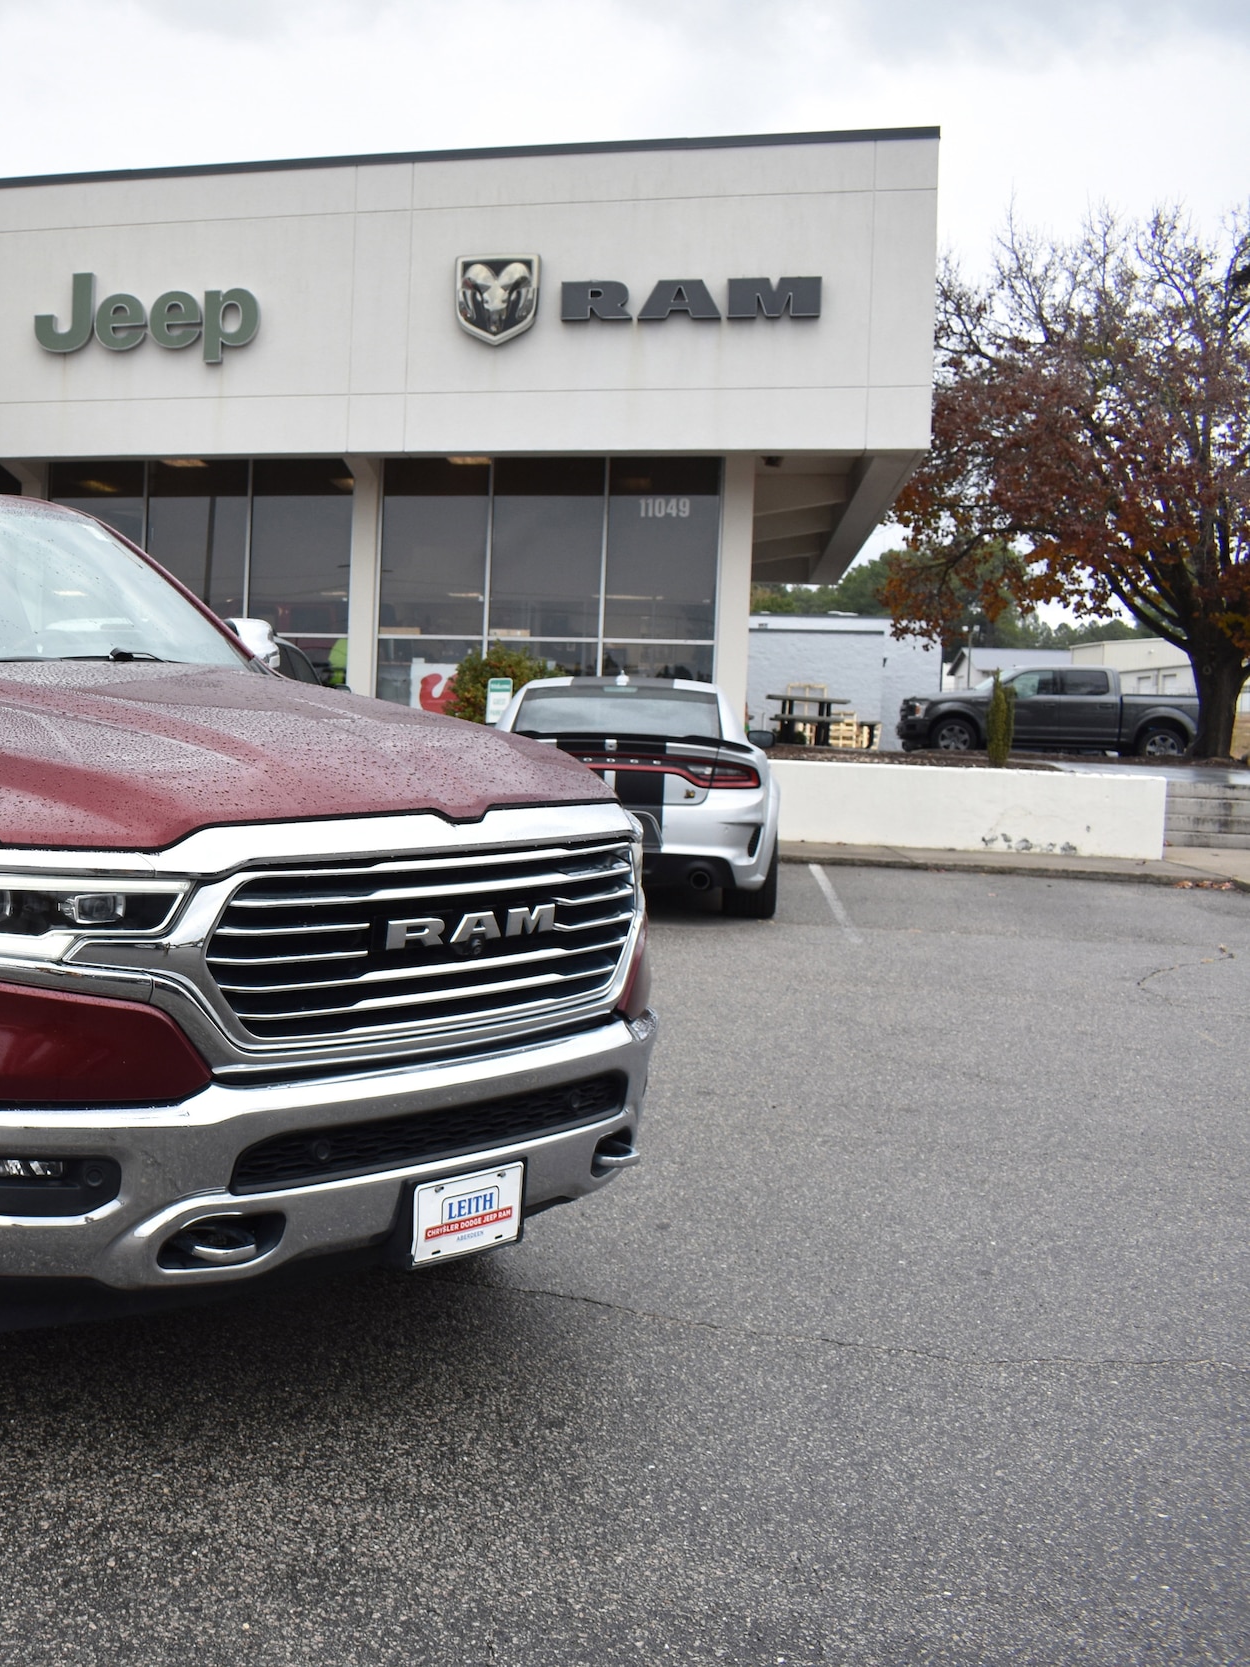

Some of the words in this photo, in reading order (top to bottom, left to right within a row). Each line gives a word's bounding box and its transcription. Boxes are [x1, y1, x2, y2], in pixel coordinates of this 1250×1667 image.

[561, 276, 823, 321] RAM
[34, 272, 261, 363] Jeep
[639, 498, 690, 517] 11049
[386, 903, 556, 950] RAM
[426, 1223, 459, 1237] CHRYSLER
[460, 1217, 482, 1229] DODGE
[483, 1213, 498, 1224] JEEP
[498, 1209, 511, 1219] RAM
[448, 1192, 494, 1220] LEITH
